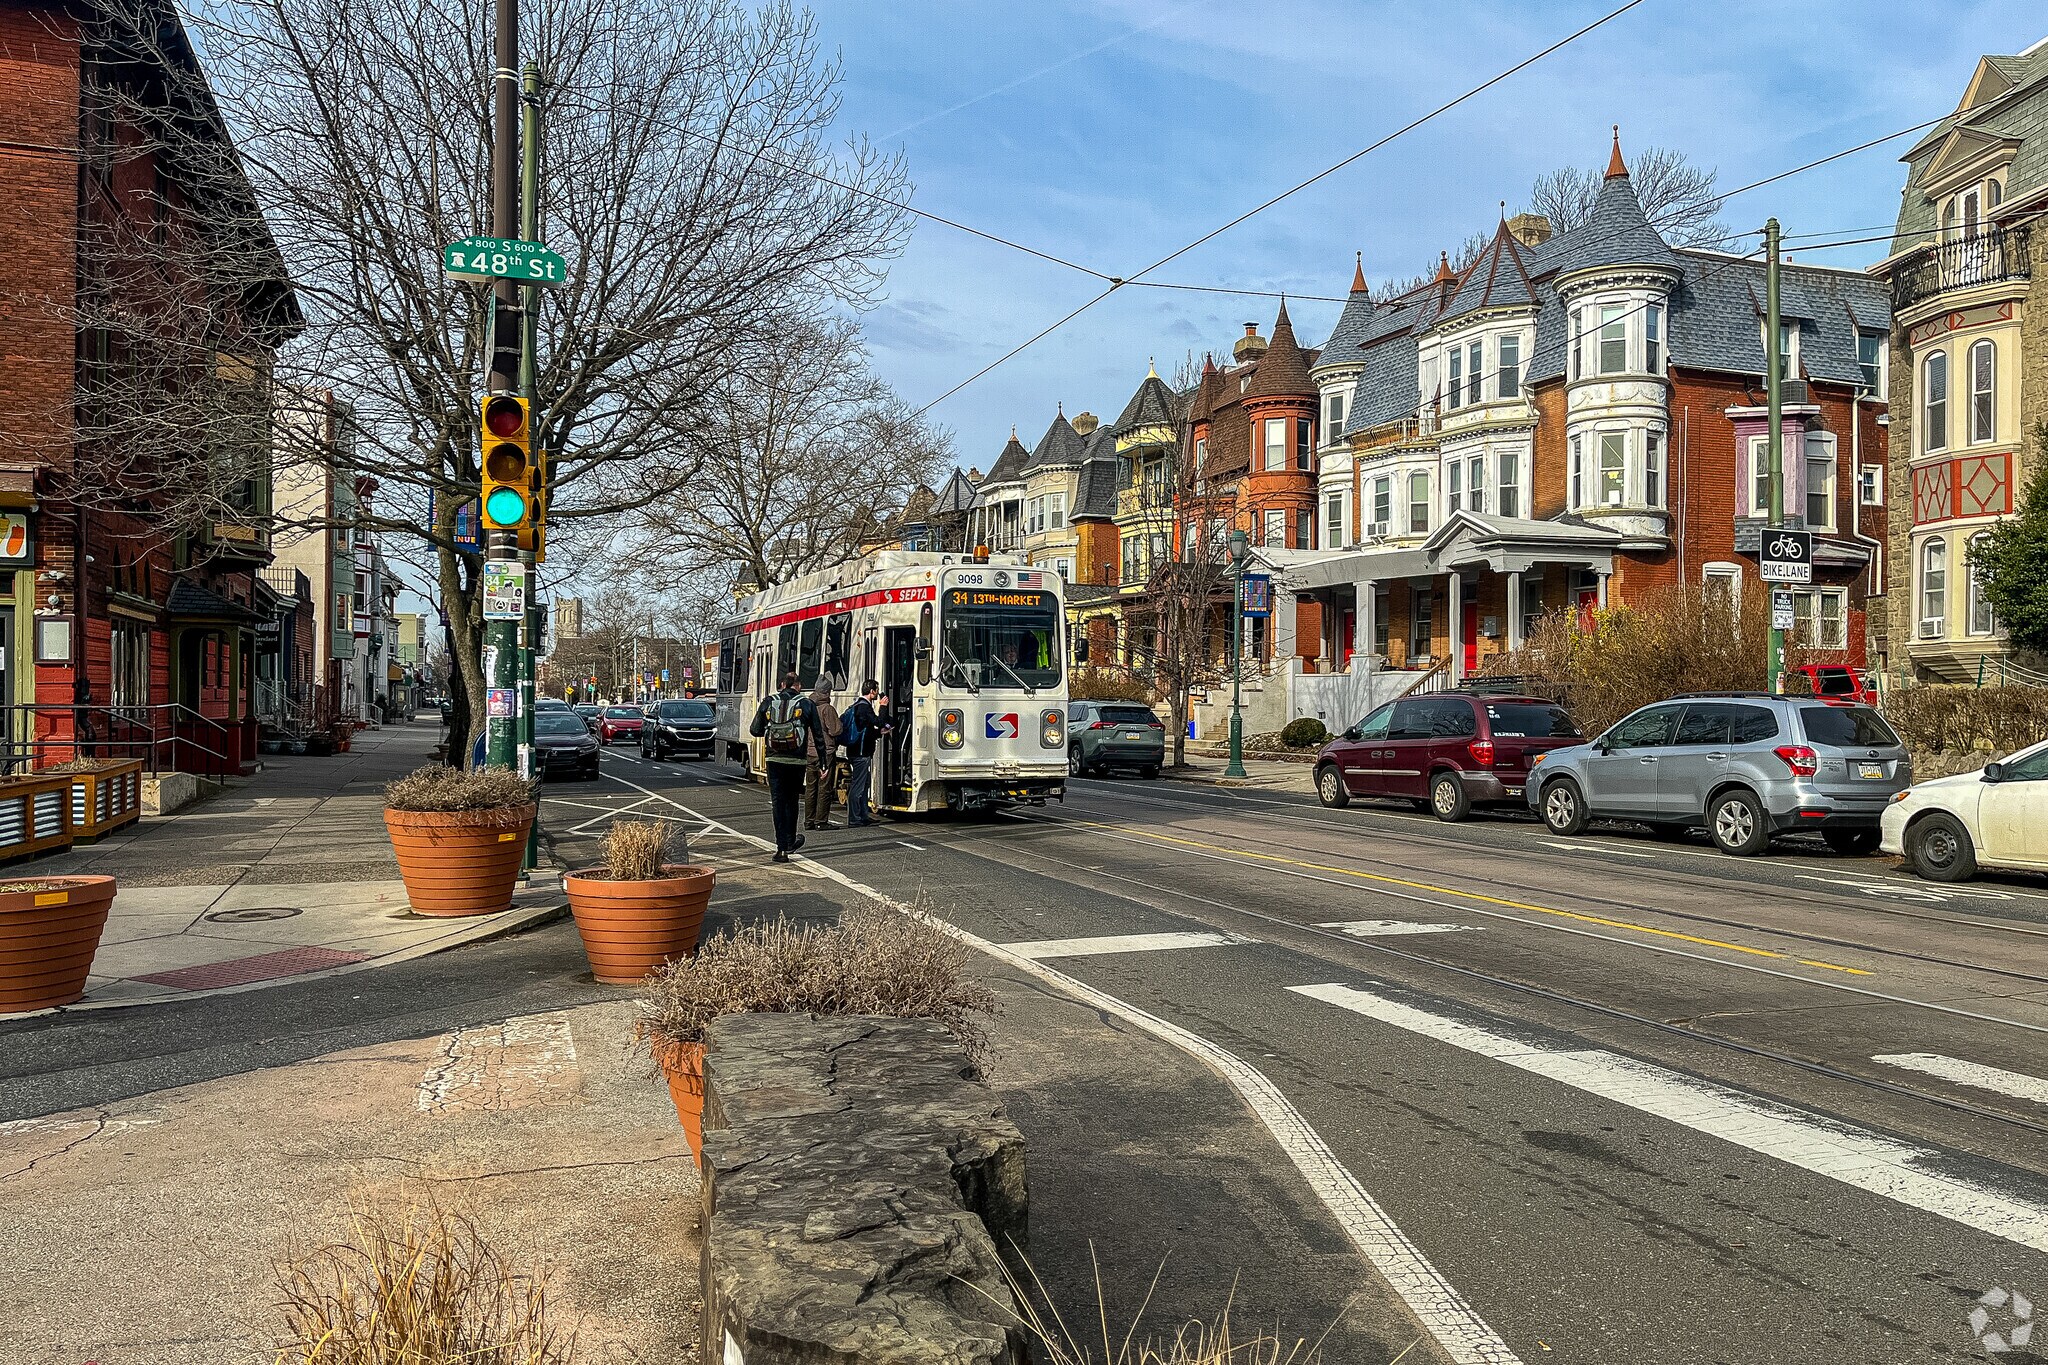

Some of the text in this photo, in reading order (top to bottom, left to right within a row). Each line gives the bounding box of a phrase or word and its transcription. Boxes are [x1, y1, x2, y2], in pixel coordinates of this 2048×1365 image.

[475, 240, 535, 253] 800 S 600
[470, 252, 556, 279] 48th St
[1763, 563, 1809, 578] BIKE LANE
[486, 575, 500, 586] 34
[957, 574, 983, 585] 9098
[899, 588, 928, 601] SEPTA
[952, 591, 1041, 606] 34 13TH-MARKET
